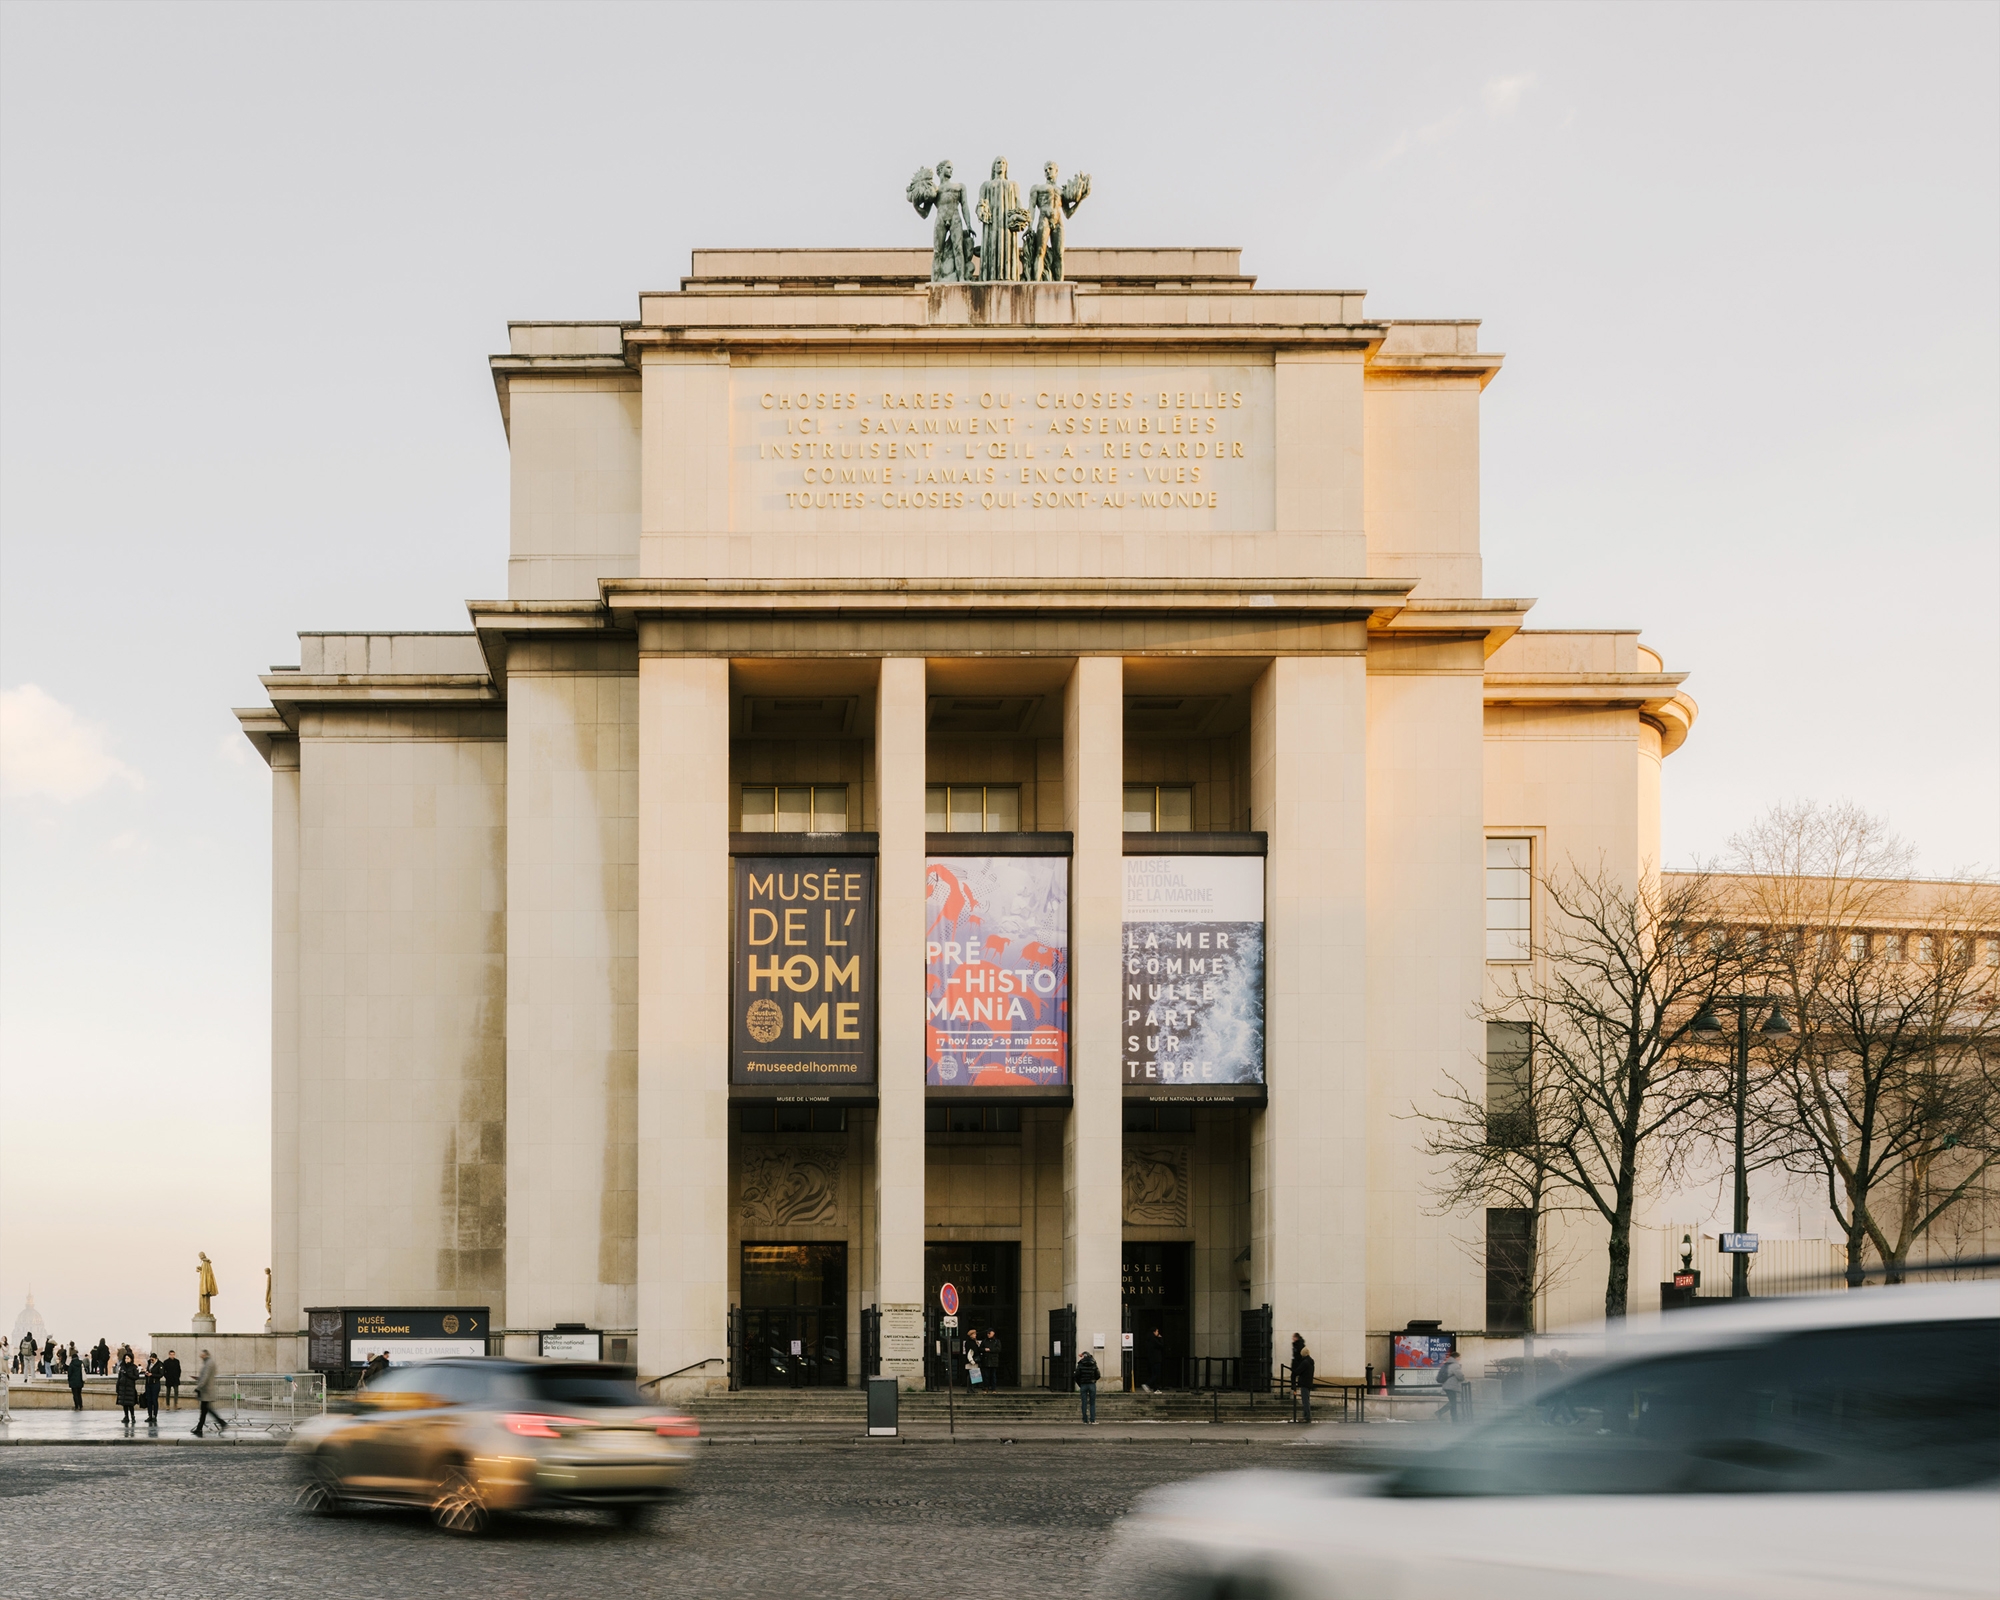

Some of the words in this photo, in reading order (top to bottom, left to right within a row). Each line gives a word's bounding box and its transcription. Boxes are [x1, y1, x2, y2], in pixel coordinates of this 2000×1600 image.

[760, 393, 858, 409] CHOSES
[882, 392, 955, 409] RARES
[980, 392, 1012, 408] OU
[1036, 392, 1134, 408] CHOSES
[1158, 392, 1243, 408] BELLES
[787, 418, 822, 434] ICI
[860, 418, 1014, 434] SAVAMMENT
[1048, 413, 1216, 434] ASSEMBLÉES
[759, 442, 933, 459] INSTRUISENT
[1061, 442, 1074, 458] A
[1104, 442, 1244, 458] REGARDER
[803, 467, 892, 484] COMME
[915, 467, 996, 484] JAMAIS
[1020, 466, 1118, 484] ENCORE
[1144, 466, 1202, 484] VUES
[786, 492, 866, 508] TOUTES
[882, 492, 964, 508] CHOSES
[980, 492, 1017, 510] QUI
[1032, 492, 1088, 508] SONT
[1101, 492, 1126, 508] AU
[1141, 492, 1218, 508] MONDE
[1128, 857, 1171, 873] MUSÉE
[748, 868, 861, 901] MUSÉE
[1128, 874, 1187, 888] NATIONAL
[1128, 888, 1143, 902] DE
[1147, 888, 1161, 902] LA
[1165, 888, 1213, 902] MARINE
[748, 908, 808, 946] DE
[825, 908, 856, 946] L'
[1128, 933, 1158, 949] LA
[1176, 932, 1230, 949] MER
[926, 936, 981, 965] PRÉ
[748, 954, 860, 992] HOM
[1128, 958, 1223, 975] COMME
[1128, 984, 1214, 1000] NULLE
[926, 998, 1027, 1020] MANiA
[794, 1002, 860, 1040] ME
[1128, 1010, 1196, 1026] PART
[936, 1038, 946, 1046] 17
[1015, 1036, 1032, 1045] mai
[1035, 1038, 1058, 1046] 2024
[1128, 1035, 1180, 1052] SUR
[747, 1062, 858, 1072] #museedelhomme
[1005, 1055, 1032, 1064] MUSÉE
[1127, 1062, 1213, 1078] TERRE
[1724, 1234, 1742, 1248] WC
[941, 1262, 988, 1272] MUSÉE
[1122, 1264, 1162, 1272] USEE
[358, 1316, 385, 1324] MUSÉE
[357, 1346, 381, 1354] MUSÉE
